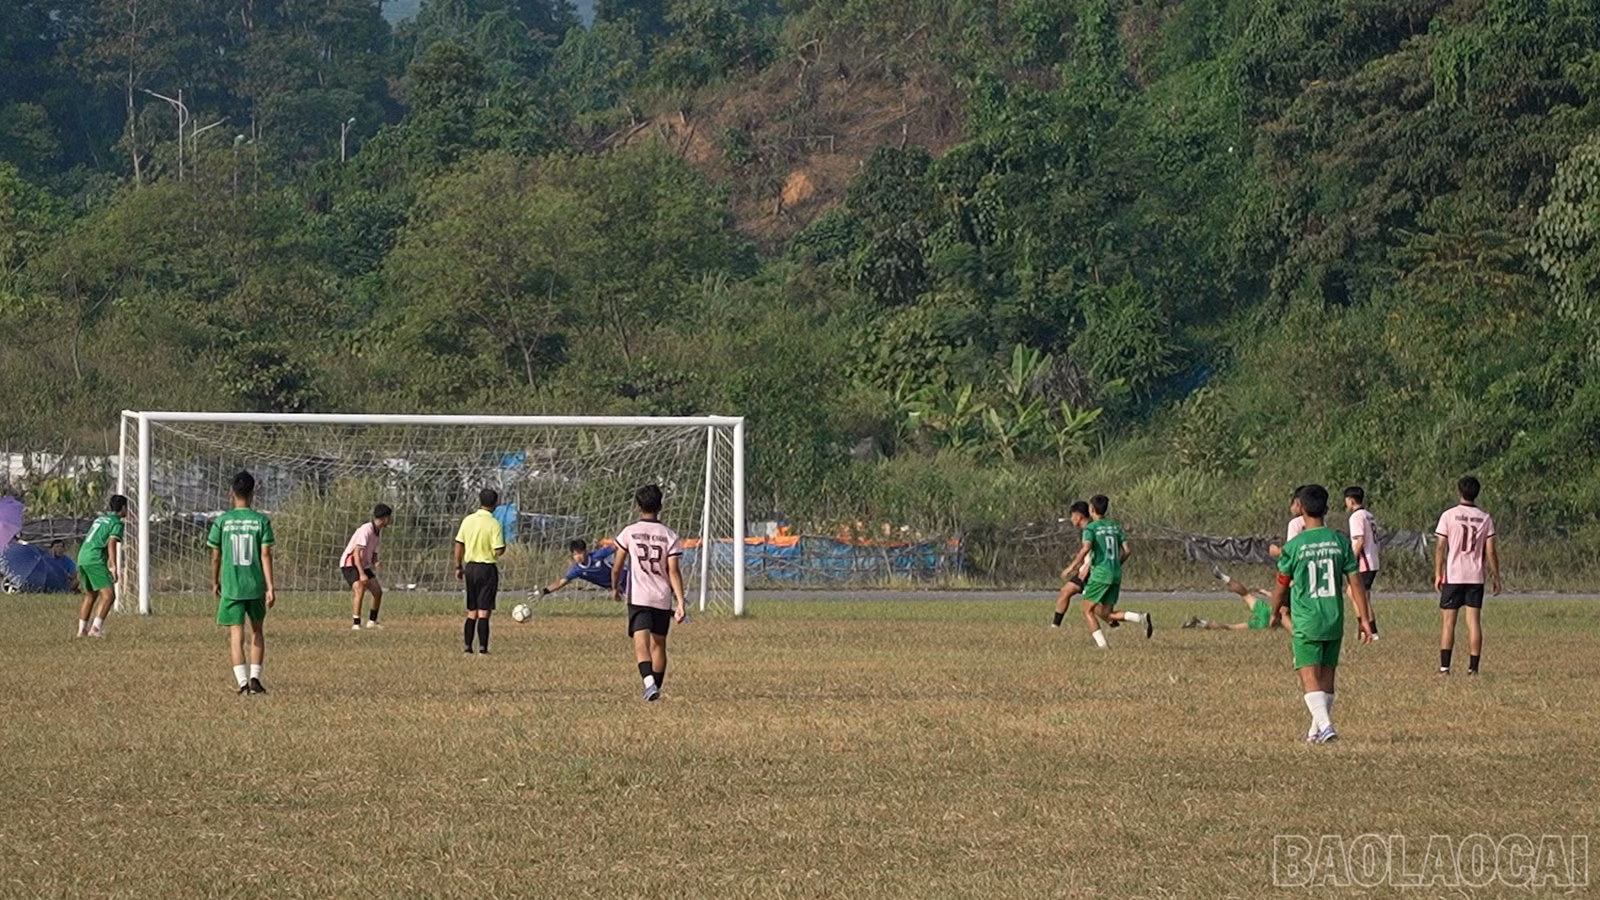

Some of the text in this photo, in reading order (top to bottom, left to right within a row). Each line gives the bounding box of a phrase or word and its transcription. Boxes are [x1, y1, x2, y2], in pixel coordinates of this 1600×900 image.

[230, 533, 254, 566] 10
[636, 543, 663, 576] 22
[1105, 535, 1115, 560] 9
[1307, 558, 1336, 598] 13
